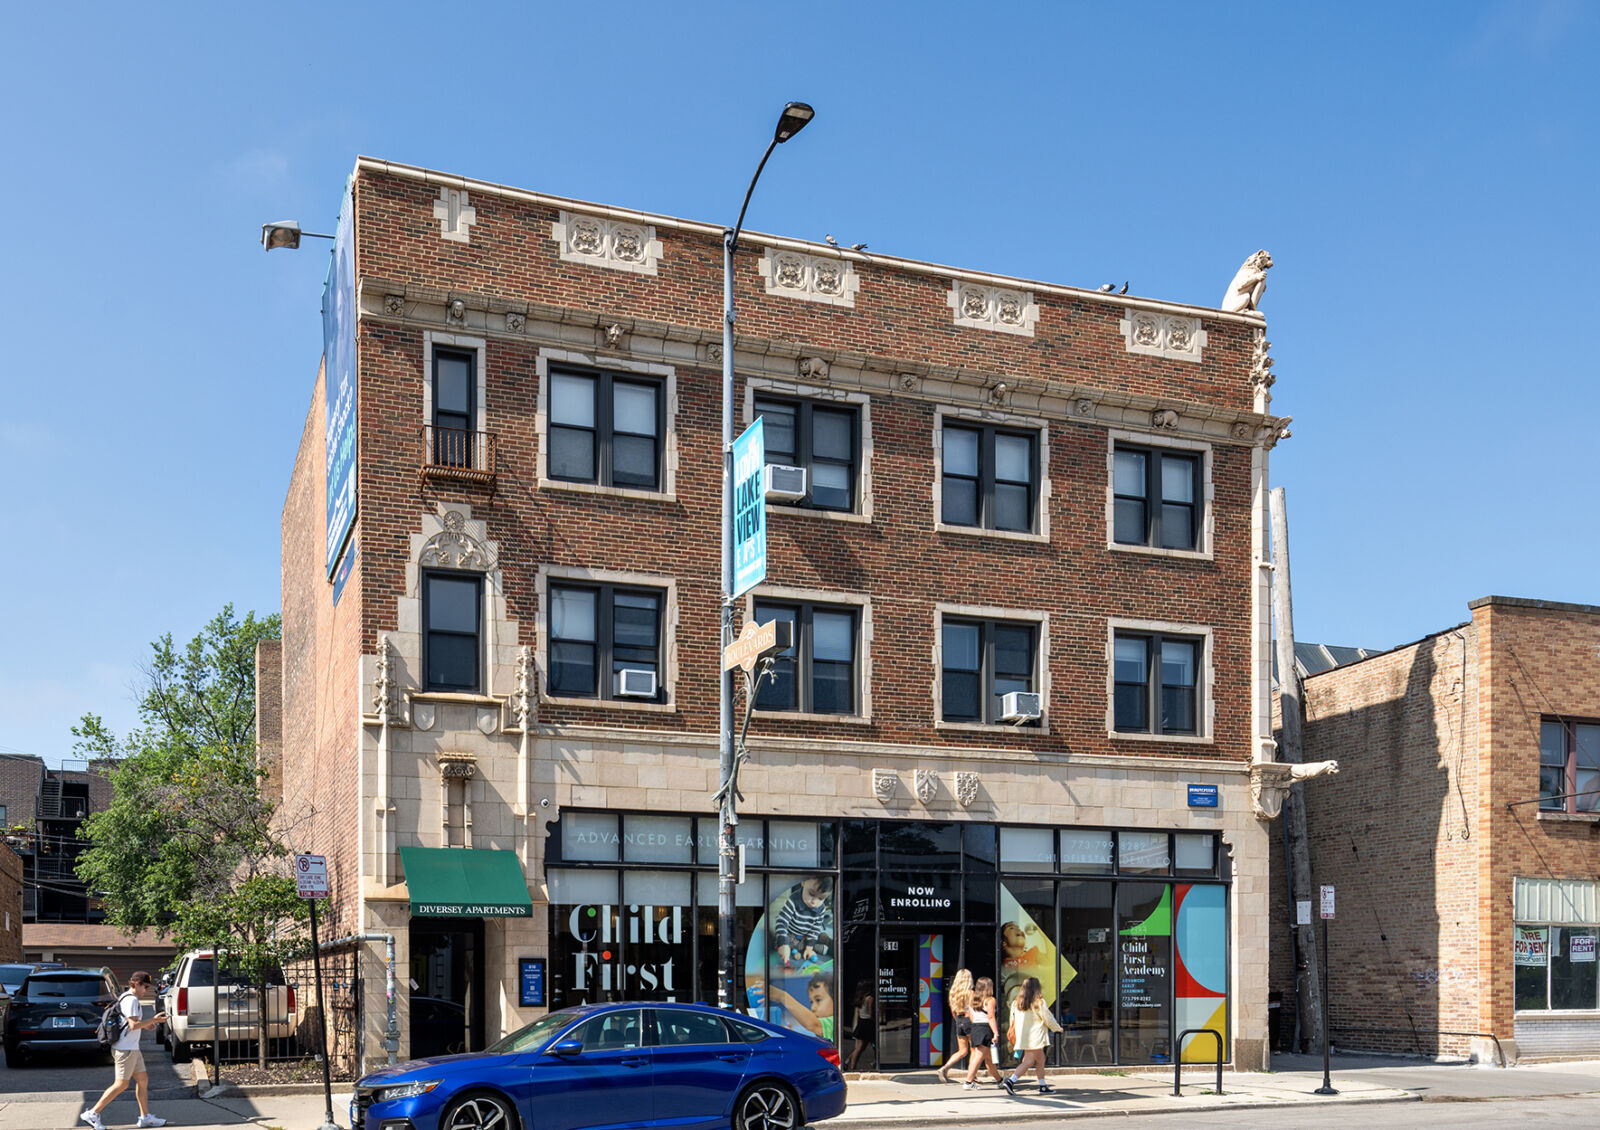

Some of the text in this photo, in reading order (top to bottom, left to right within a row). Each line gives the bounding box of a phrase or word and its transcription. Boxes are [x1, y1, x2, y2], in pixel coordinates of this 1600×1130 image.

[736, 470, 760, 515] LAKE
[736, 501, 761, 545] VIEW
[736, 533, 762, 569] EAST
[577, 831, 667, 846] ADVANCED
[735, 836, 808, 850] EARNING
[908, 887, 935, 895] NOW
[890, 898, 951, 907] ENROLLING
[419, 905, 526, 915] DIVERSEY APARTMENTS
[569, 904, 682, 944] Child
[1122, 942, 1148, 953] Child
[1123, 953, 1146, 964] First
[572, 951, 675, 991] First
[879, 968, 894, 976] hild
[1123, 965, 1166, 977] Academy
[879, 985, 907, 994] cademy
